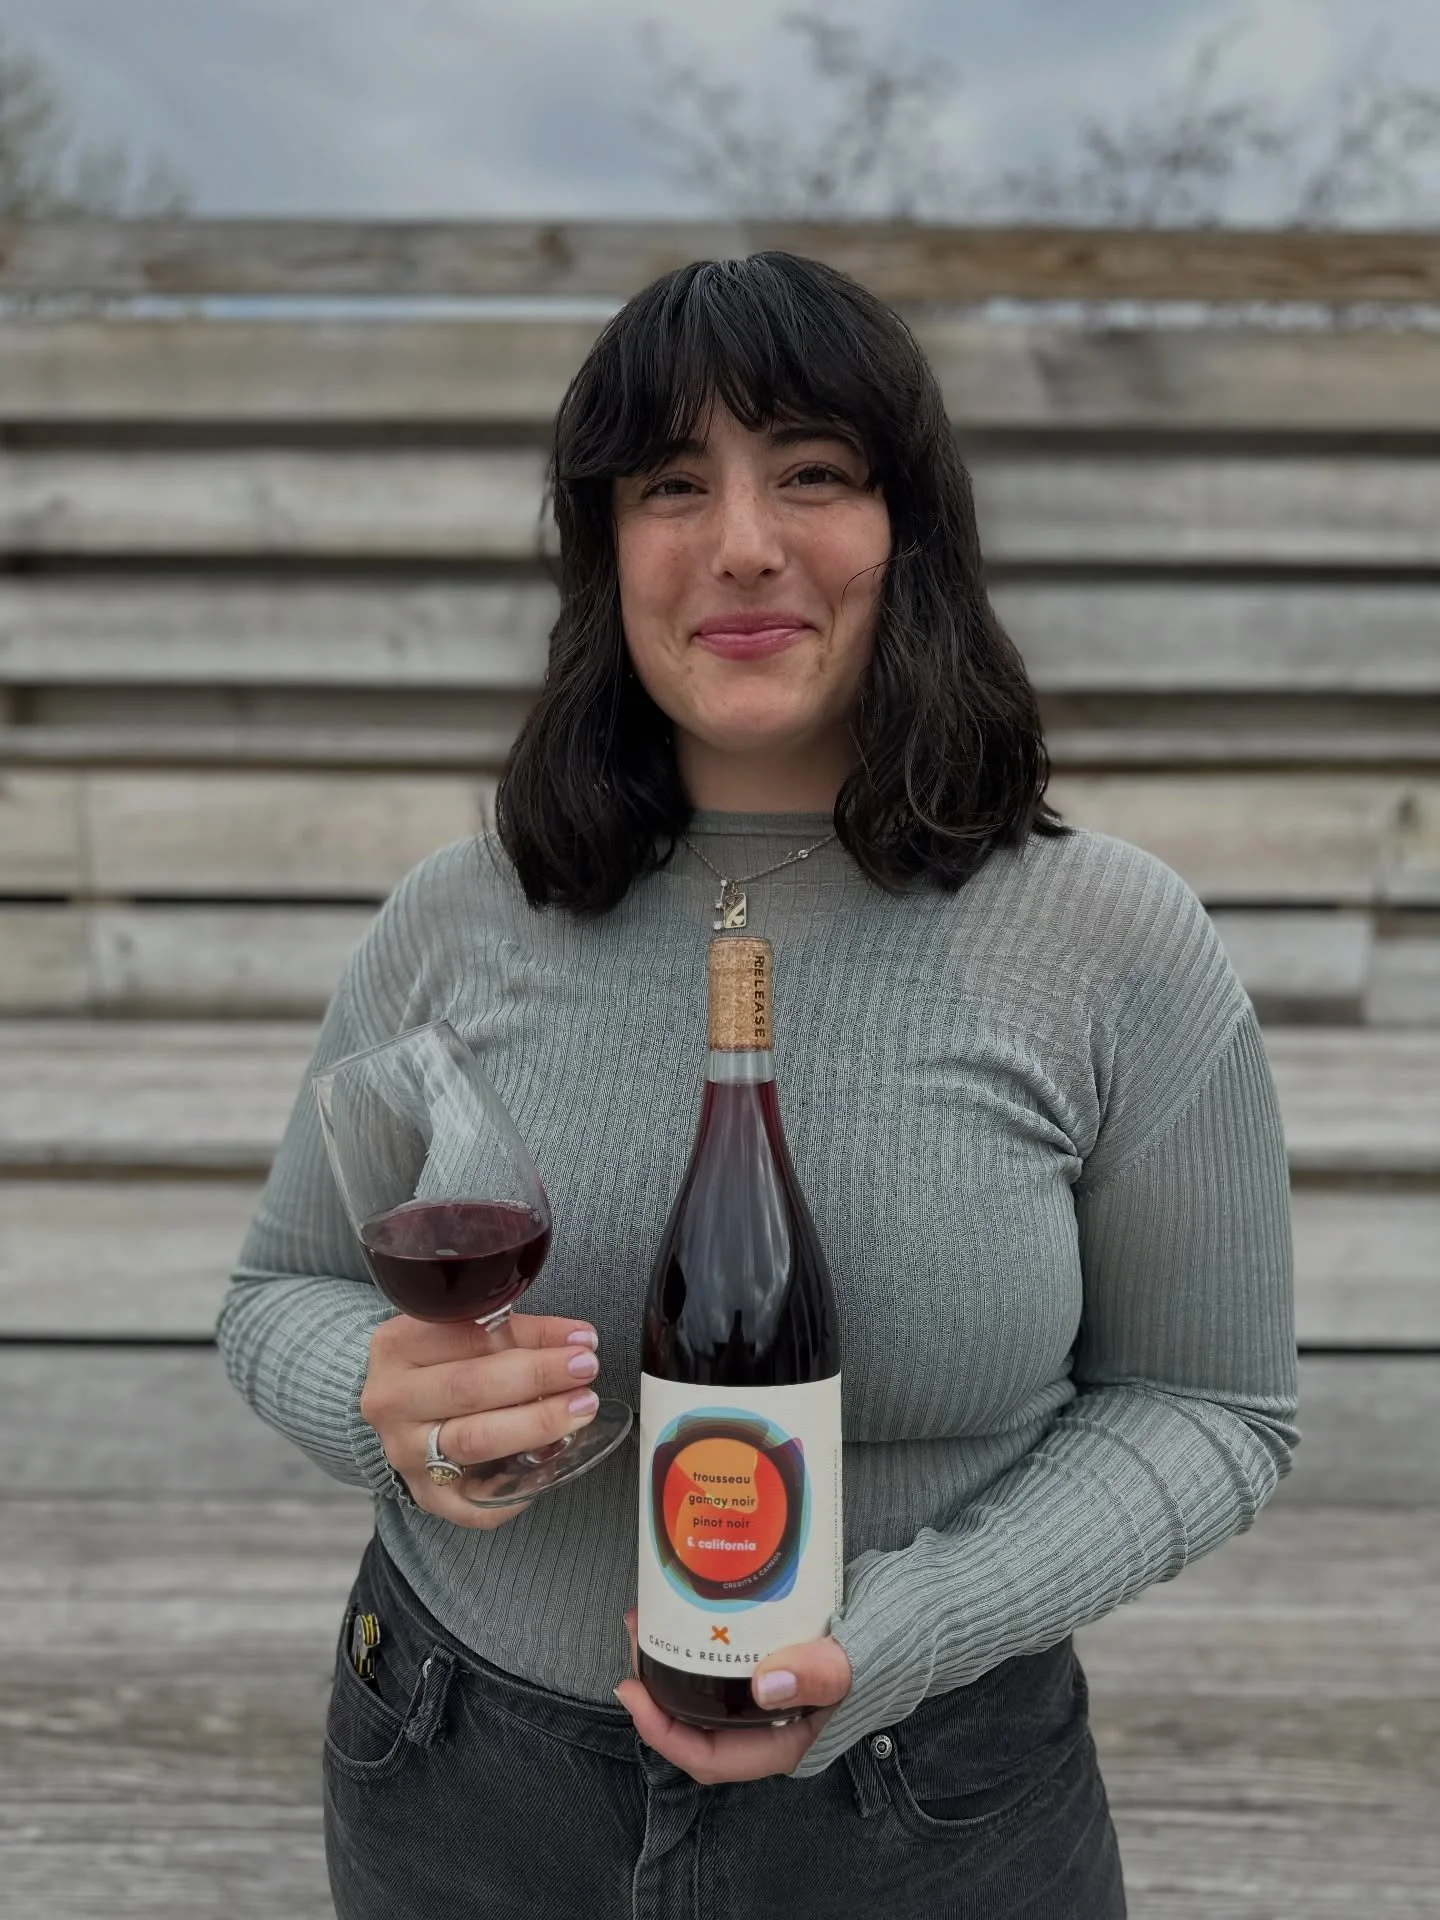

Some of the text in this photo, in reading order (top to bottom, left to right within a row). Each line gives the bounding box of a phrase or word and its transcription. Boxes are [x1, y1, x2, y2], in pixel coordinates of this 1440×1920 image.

[754, 955, 766, 1039] RELEASE
[693, 1471, 751, 1485] trousseau
[688, 1494, 756, 1508] gamay noir
[692, 1516, 751, 1529] pinot noir
[687, 1535, 757, 1551] & california
[723, 1577, 753, 1589] CREDITS
[649, 1634, 680, 1655] CATCH
[685, 1648, 693, 1658] &
[699, 1651, 761, 1664] RELEASE
